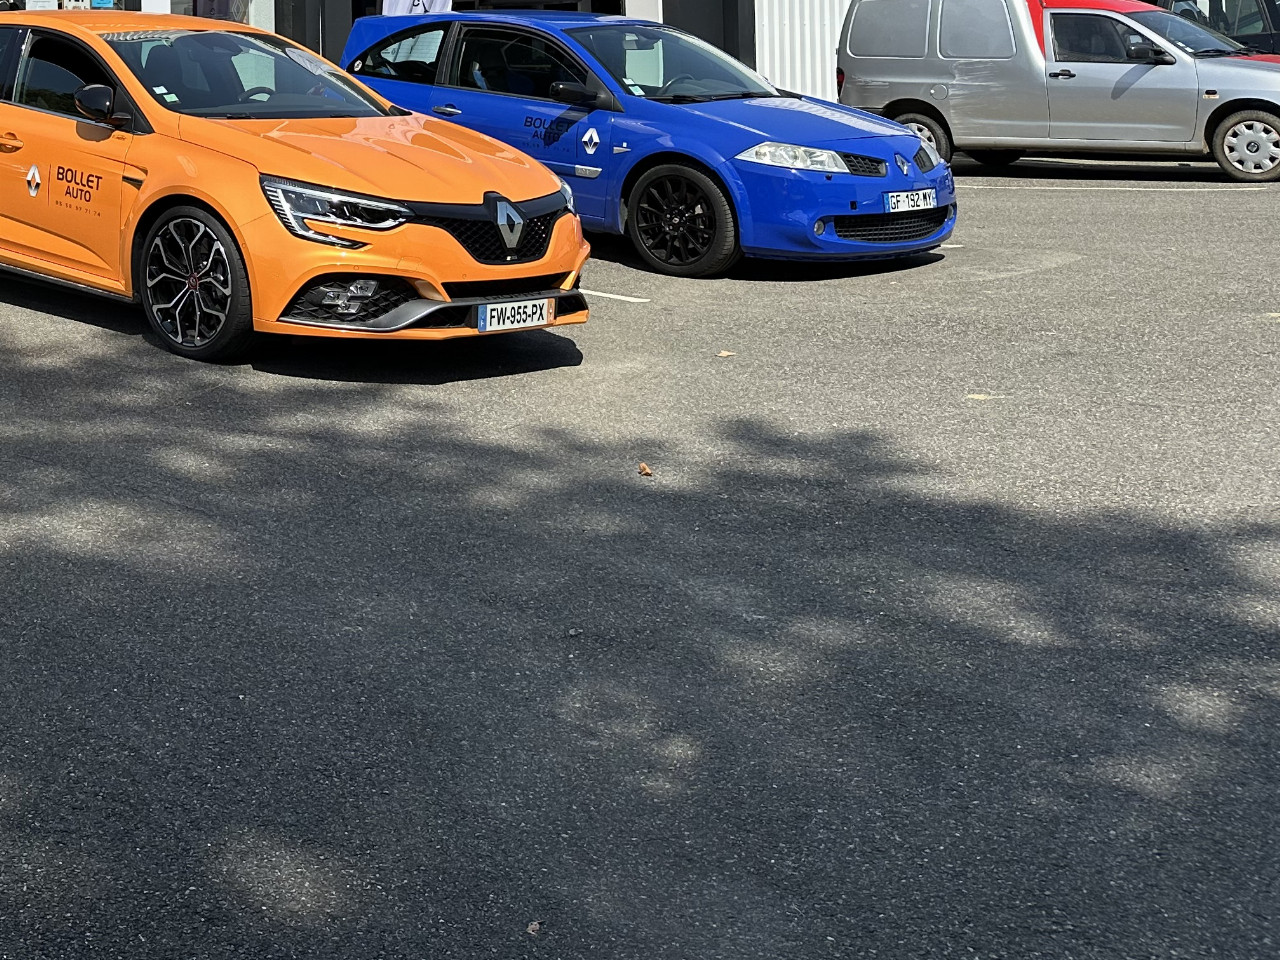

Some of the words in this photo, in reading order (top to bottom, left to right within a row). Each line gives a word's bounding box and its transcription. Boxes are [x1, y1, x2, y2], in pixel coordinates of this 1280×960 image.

[56, 165, 103, 191] BOLLET
[64, 185, 92, 203] AUTO
[489, 302, 545, 327] FW-955-PX
